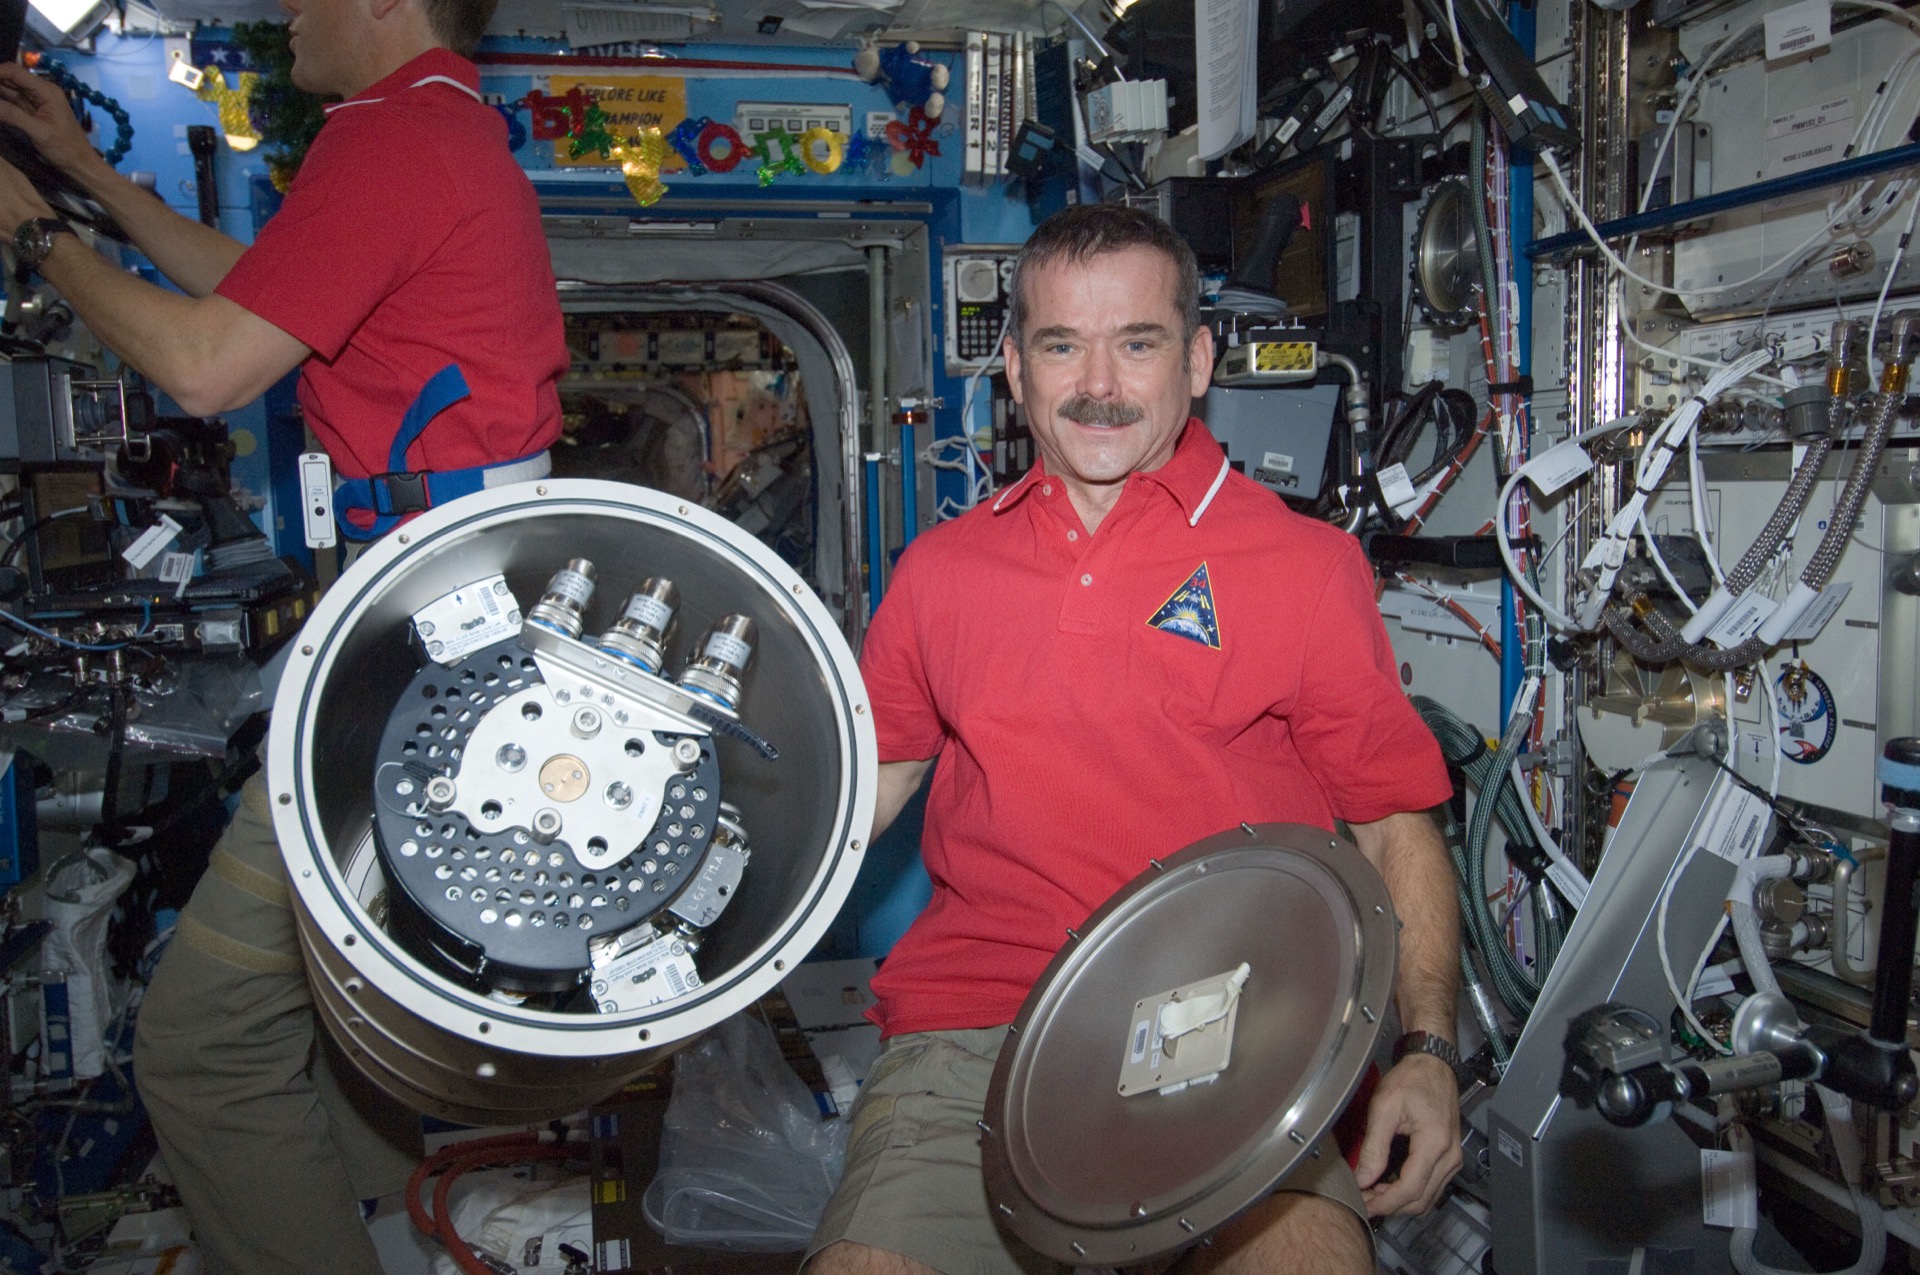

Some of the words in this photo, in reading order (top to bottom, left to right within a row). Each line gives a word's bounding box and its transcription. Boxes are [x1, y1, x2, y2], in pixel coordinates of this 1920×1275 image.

[638, 89, 667, 103] LIKE
[1002, 74, 1012, 151] WARNING
[1190, 578, 1206, 588] 34
[688, 883, 707, 910] LGF
